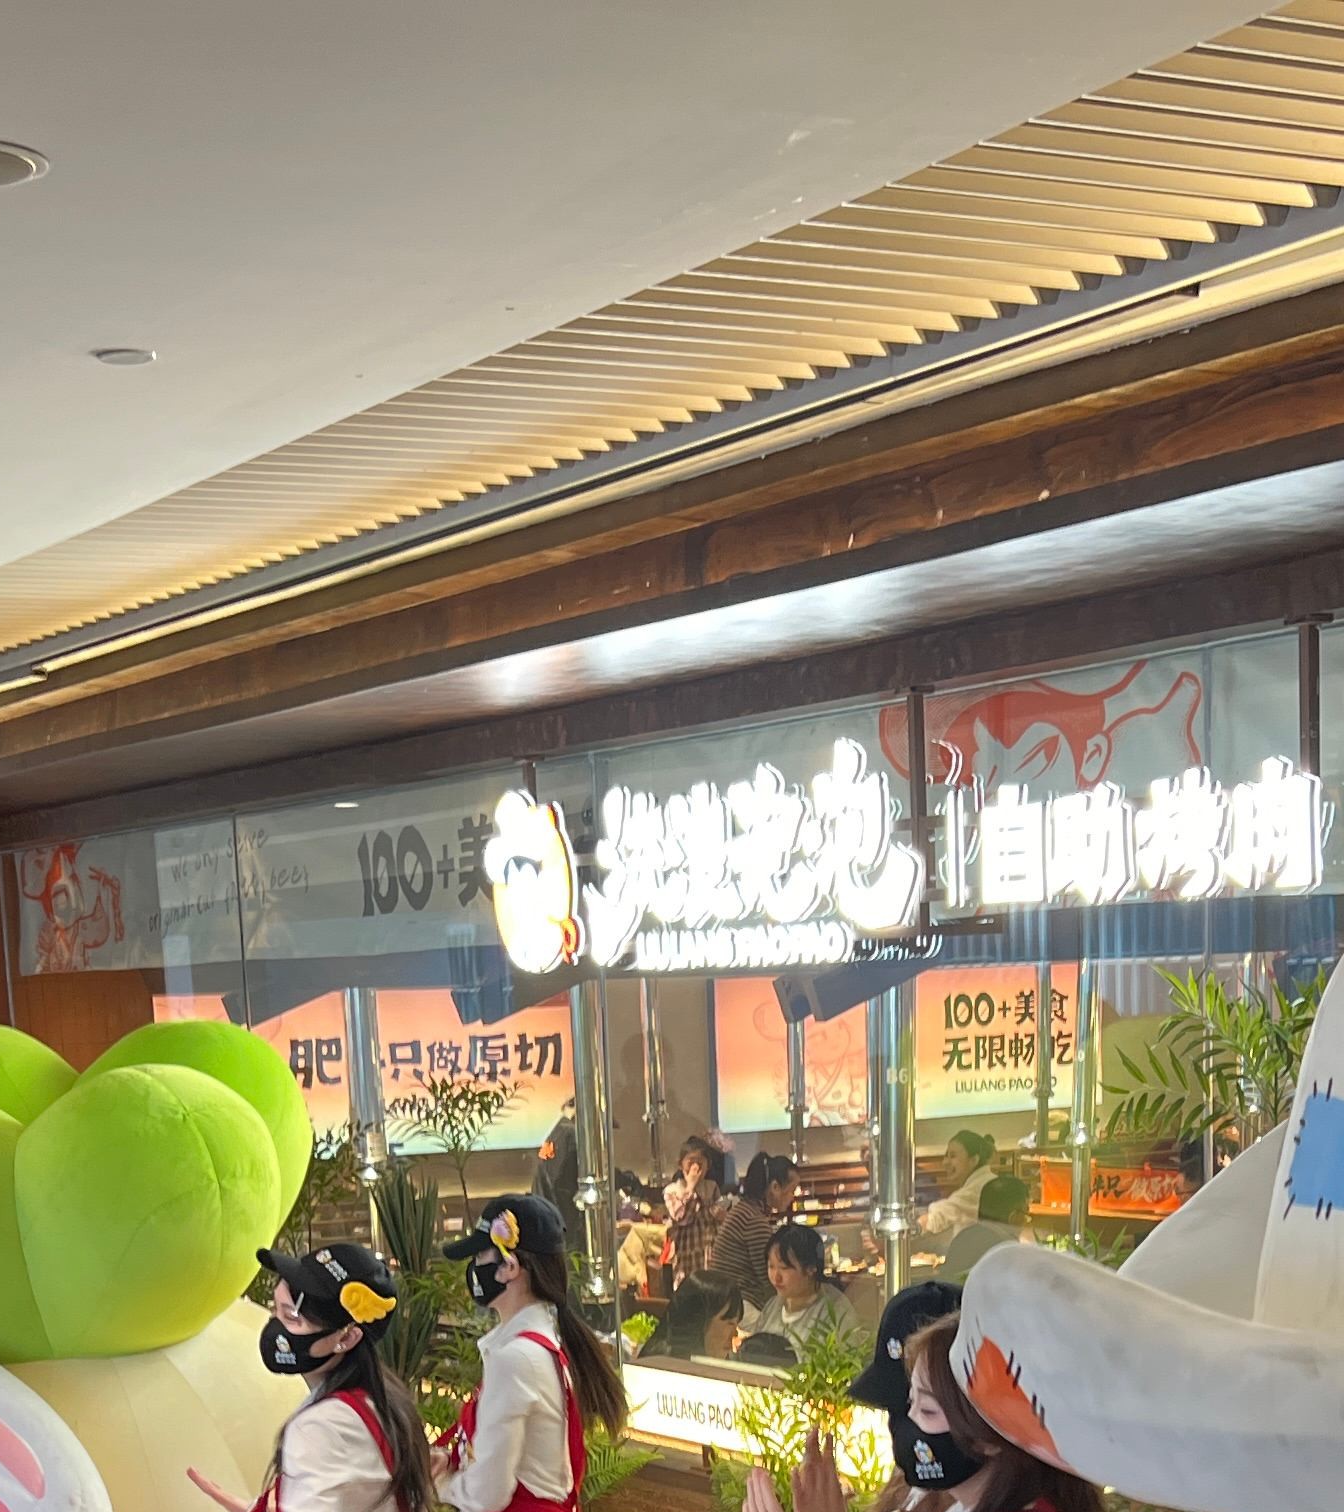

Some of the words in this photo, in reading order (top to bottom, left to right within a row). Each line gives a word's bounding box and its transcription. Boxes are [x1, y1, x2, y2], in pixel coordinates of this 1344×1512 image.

[289, 1032, 563, 1088] 肥只做原切
[942, 1031, 1074, 1073] 无限畅吃
[955, 1078, 1006, 1094] LIULANG
[1009, 1075, 1058, 1090] PAOO
[657, 1391, 705, 1425] LIULANG
[708, 1403, 738, 1431] PAO
